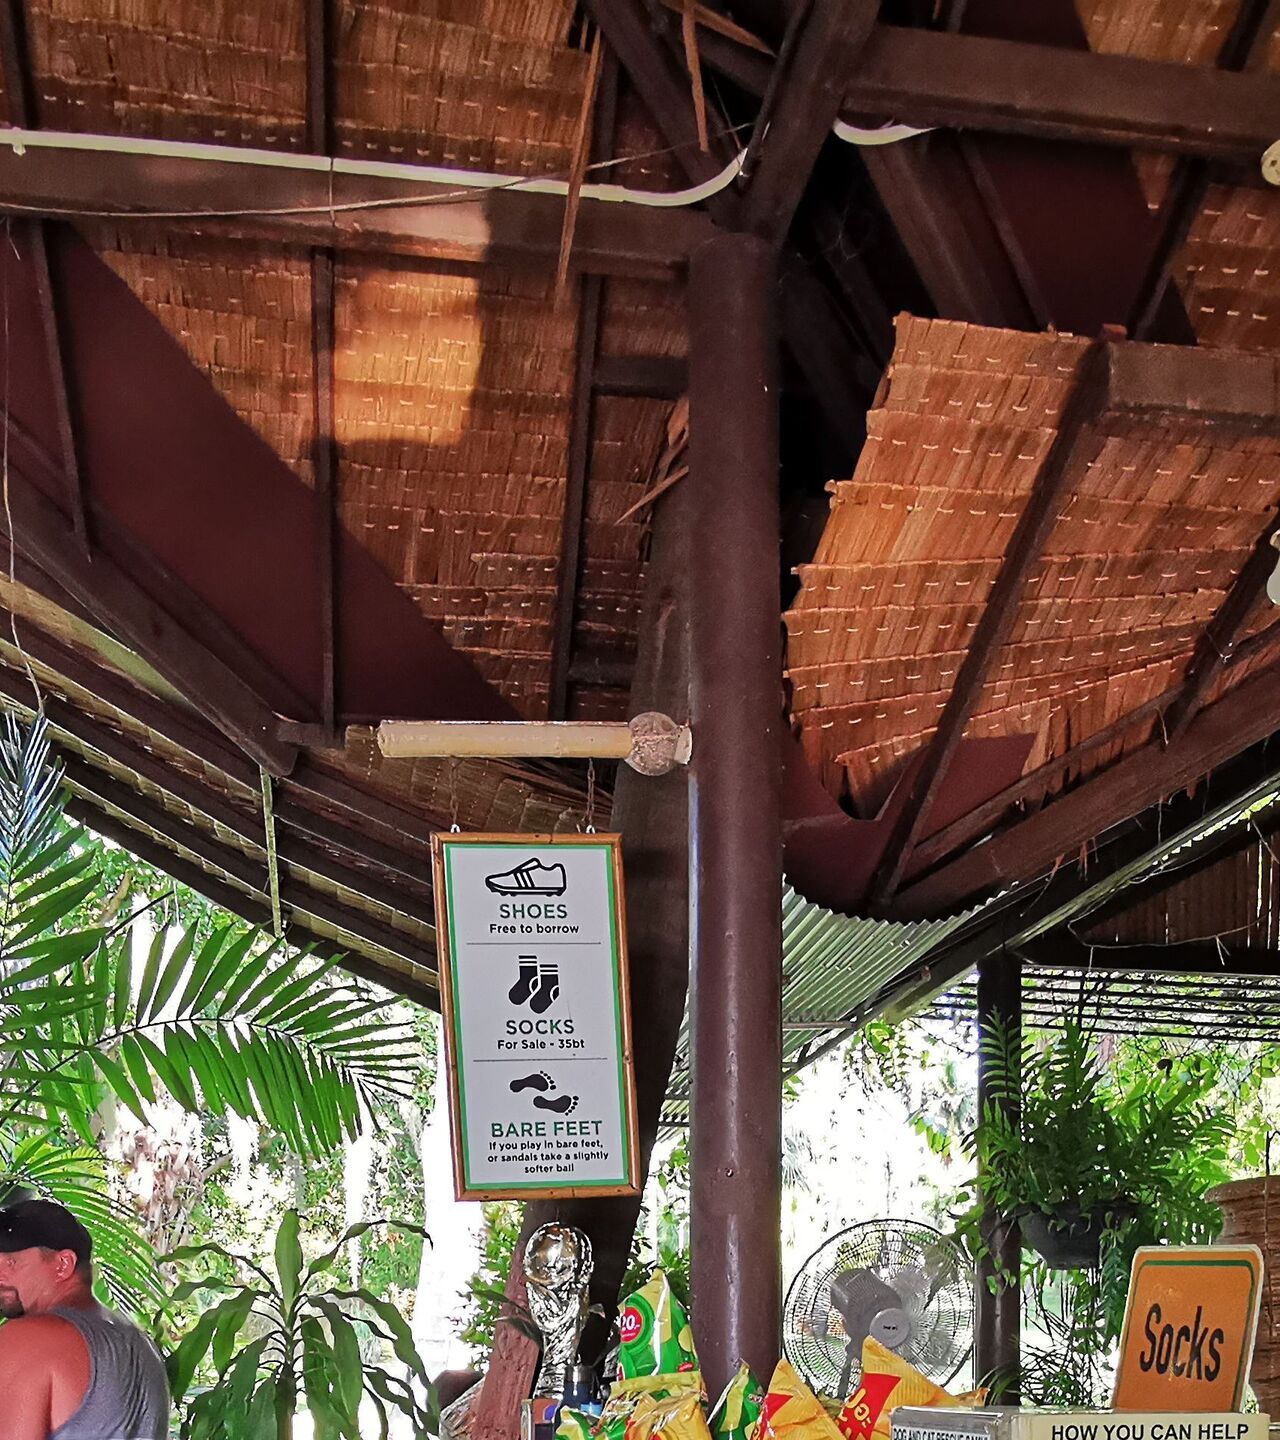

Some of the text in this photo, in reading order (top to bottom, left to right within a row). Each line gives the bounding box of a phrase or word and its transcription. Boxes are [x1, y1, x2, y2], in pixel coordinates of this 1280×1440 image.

[499, 904, 568, 920] SHOES
[489, 923, 580, 935] Free to borrow
[506, 1019, 575, 1035] SOCKS
[497, 1039, 518, 1050] For
[521, 1039, 547, 1050] Sale
[558, 1038, 585, 1050] 35bt
[491, 1120, 603, 1138] BARE FEET
[499, 1143, 518, 1151] you
[520, 1141, 541, 1150] play
[556, 1140, 579, 1149] bare
[581, 1139, 603, 1149] feet,
[488, 1155, 498, 1163] or
[501, 1153, 538, 1162] sandals
[540, 1152, 563, 1161] take
[573, 1151, 608, 1162] slightly
[524, 1163, 575, 1173] softer ball
[1138, 1302, 1225, 1383] Socks
[1103, 1424, 1144, 1440] YOU
[1150, 1424, 1192, 1440] CAN
[1198, 1423, 1249, 1440] HELP
